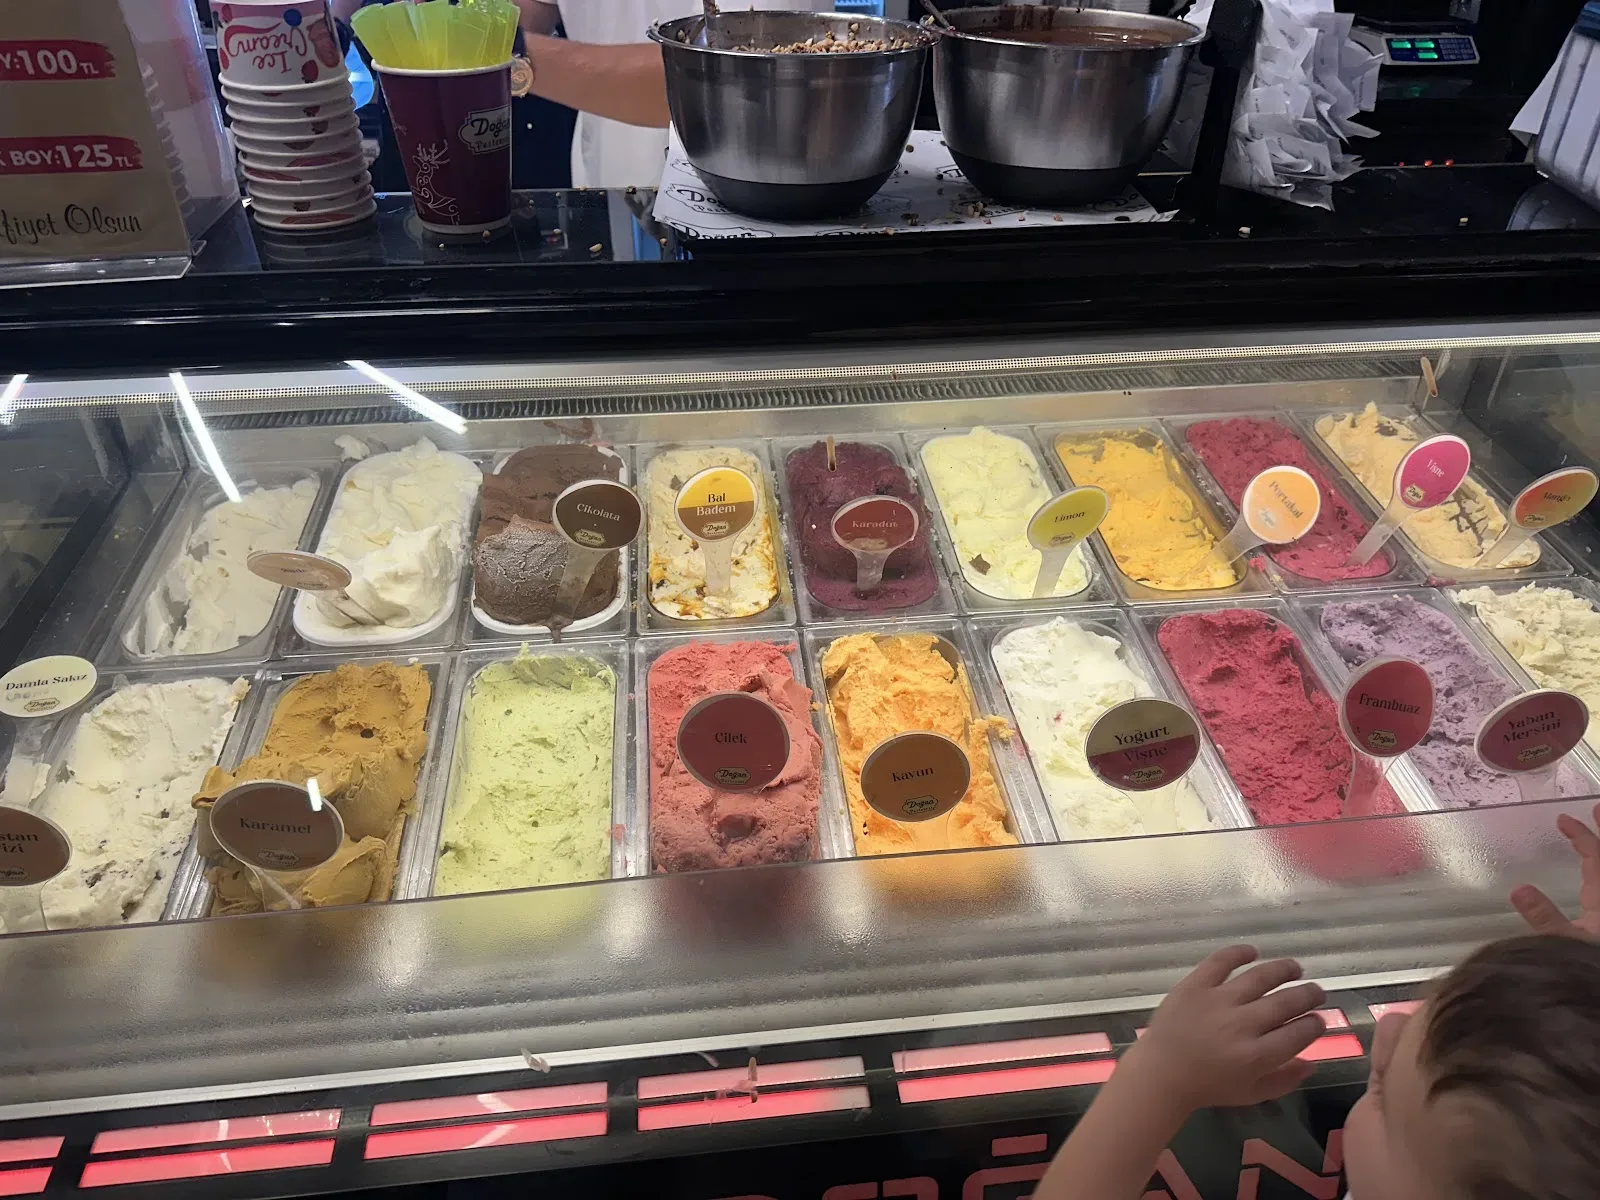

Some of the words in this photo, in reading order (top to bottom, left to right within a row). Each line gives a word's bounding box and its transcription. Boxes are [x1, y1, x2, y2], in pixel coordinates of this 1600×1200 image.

[226, 26, 308, 57] Cream
[251, 51, 292, 74] Ice
[64, 203, 142, 234] Olsun
[708, 492, 726, 503] Bal
[1269, 481, 1304, 519] Portakal
[576, 503, 620, 521] Çikolata
[696, 505, 736, 516] Badem
[1054, 511, 1085, 522] Limon
[6, 679, 48, 690] Damla
[52, 674, 87, 684] Sakız
[1359, 693, 1421, 715] Frambuaz
[1508, 711, 1555, 730] Yaban
[1114, 726, 1170, 745] Yoğurt
[1503, 719, 1560, 744] Mersini
[892, 767, 934, 782] Kavun
[240, 818, 311, 834] Karamel
